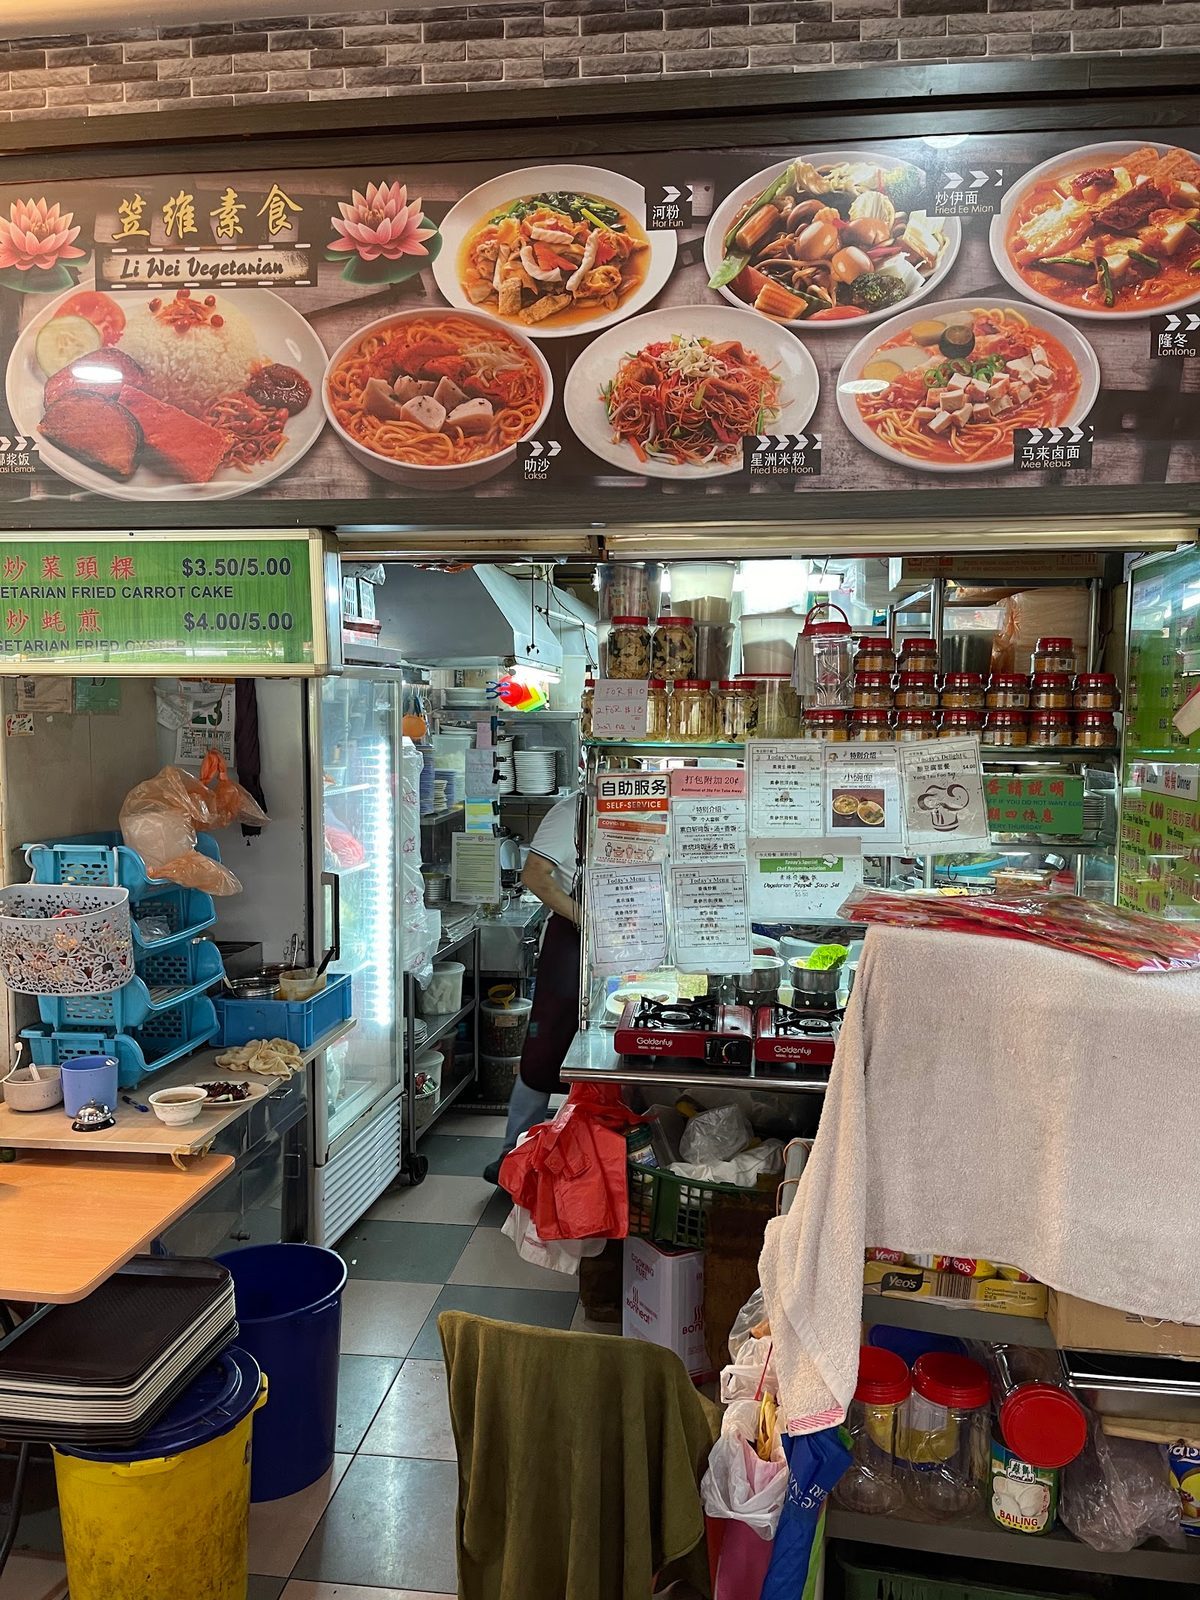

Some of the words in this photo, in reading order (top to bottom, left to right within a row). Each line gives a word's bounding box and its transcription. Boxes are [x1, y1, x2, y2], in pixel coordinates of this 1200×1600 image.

[935, 191, 978, 206] 炒伊面
[111, 183, 304, 241] 笠維素食
[652, 204, 680, 220] 河粉
[935, 205, 957, 214] Fried
[958, 205, 969, 213] Ee
[971, 204, 994, 213] Mian
[652, 219, 667, 228] Hor
[668, 219, 684, 228] Fun
[120, 258, 140, 280] Li
[146, 257, 181, 279] Wei
[186, 257, 284, 280] Vegetarian
[1158, 332, 1188, 348] 隆冬
[750, 452, 806, 467] 星洲米粉
[1021, 445, 1081, 461] 马来卤面
[11, 465, 36, 473] Lemak
[524, 458, 551, 472] 叻沙
[750, 466, 771, 474] Fried
[772, 466, 788, 474] Bee
[790, 466, 814, 474] Hoon
[1020, 460, 1042, 469] Mee
[1043, 459, 1075, 468] Rebus
[524, 472, 547, 480] Laksa
[3, 555, 136, 581] 炒菜頭粿
[182, 557, 292, 578] $3.50/5.00
[72, 586, 116, 598] FRIED
[121, 586, 186, 599] CARROT
[191, 586, 234, 598] CAKE
[6, 608, 102, 634] 炒蚝煎
[184, 612, 293, 632] $4.00/5.00
[75, 639, 119, 652] FRIED
[602, 780, 666, 796] 自助服务
[606, 800, 662, 811] SELF-SERVICE
[636, 1037, 673, 1047] Goldenfuji
[774, 1045, 812, 1056] Goldenfuji
[631, 1253, 655, 1277] COOKING
[635, 1265, 649, 1280] FUEL
[889, 1275, 917, 1289] Yeo's
[1000, 1509, 1038, 1527] BAILING
